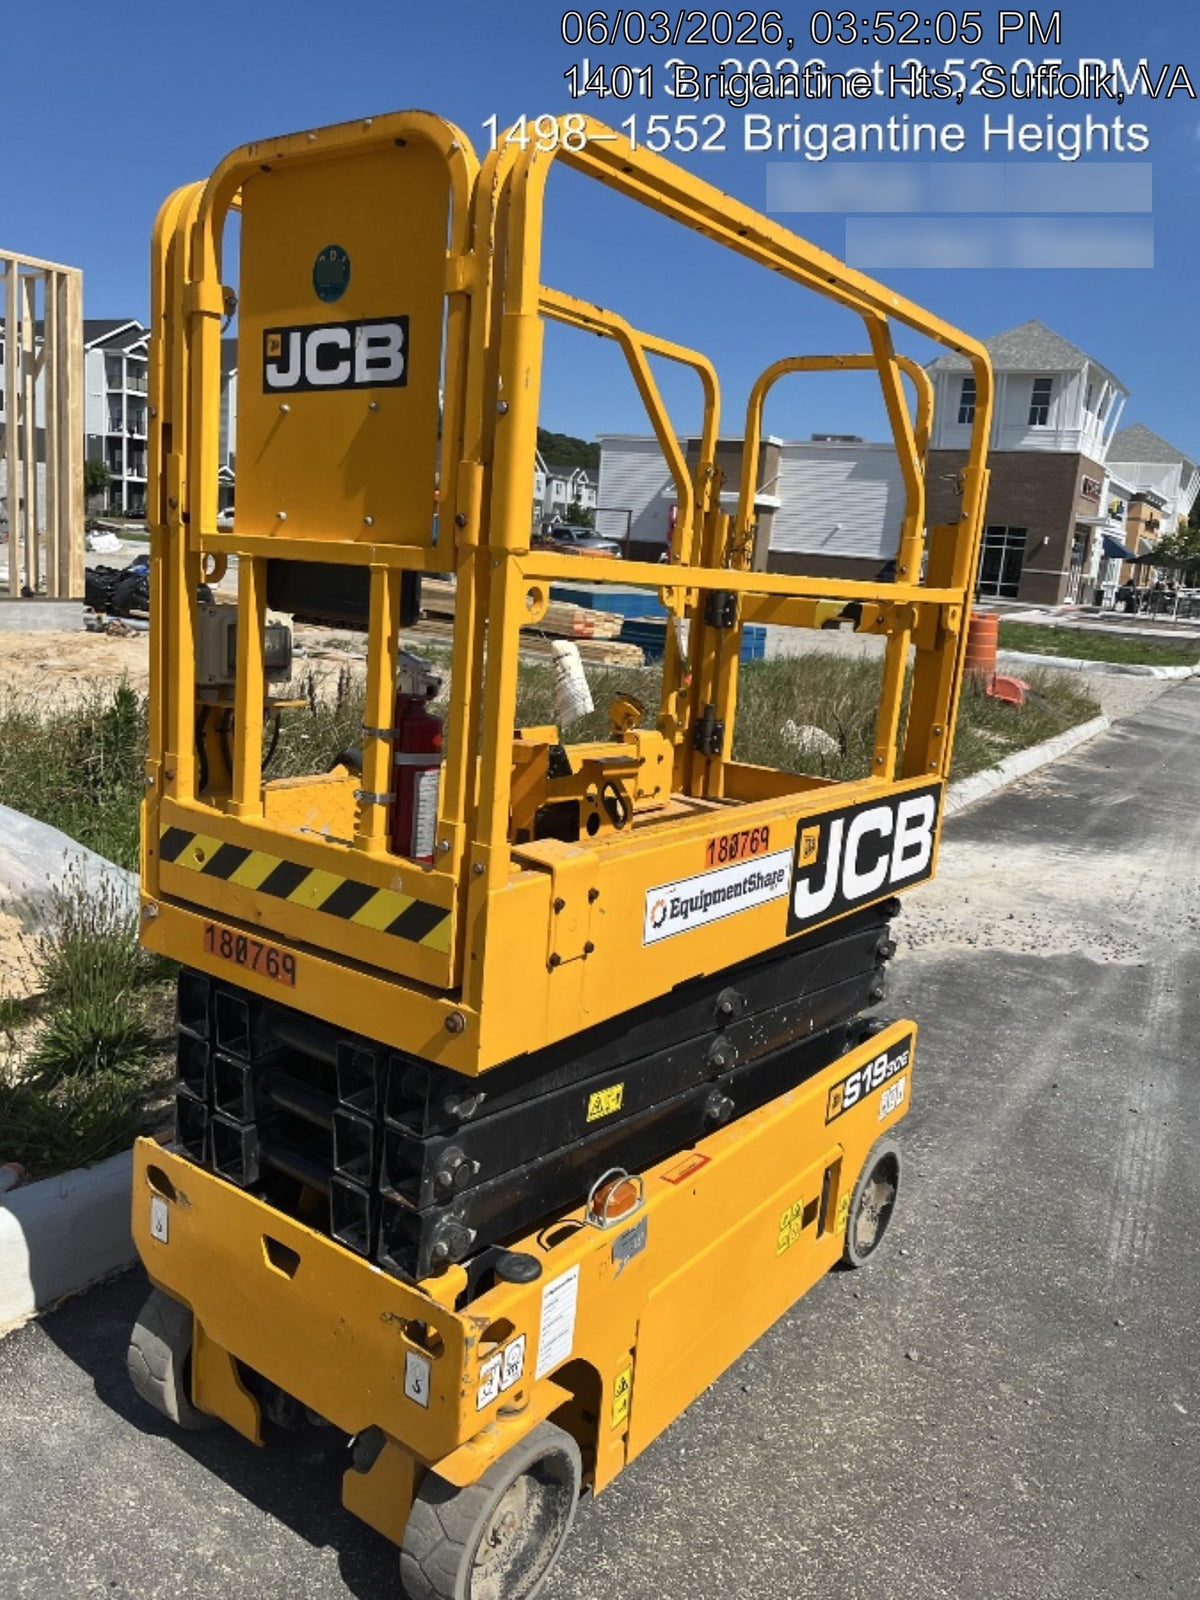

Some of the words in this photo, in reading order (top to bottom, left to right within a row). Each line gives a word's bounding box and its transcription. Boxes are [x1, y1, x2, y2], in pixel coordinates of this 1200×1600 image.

[265, 322, 405, 388] JCB
[707, 825, 770, 866] 180769
[794, 793, 936, 919] JCB
[668, 866, 785, 920] EquipmentShare
[205, 923, 296, 987] 180769
